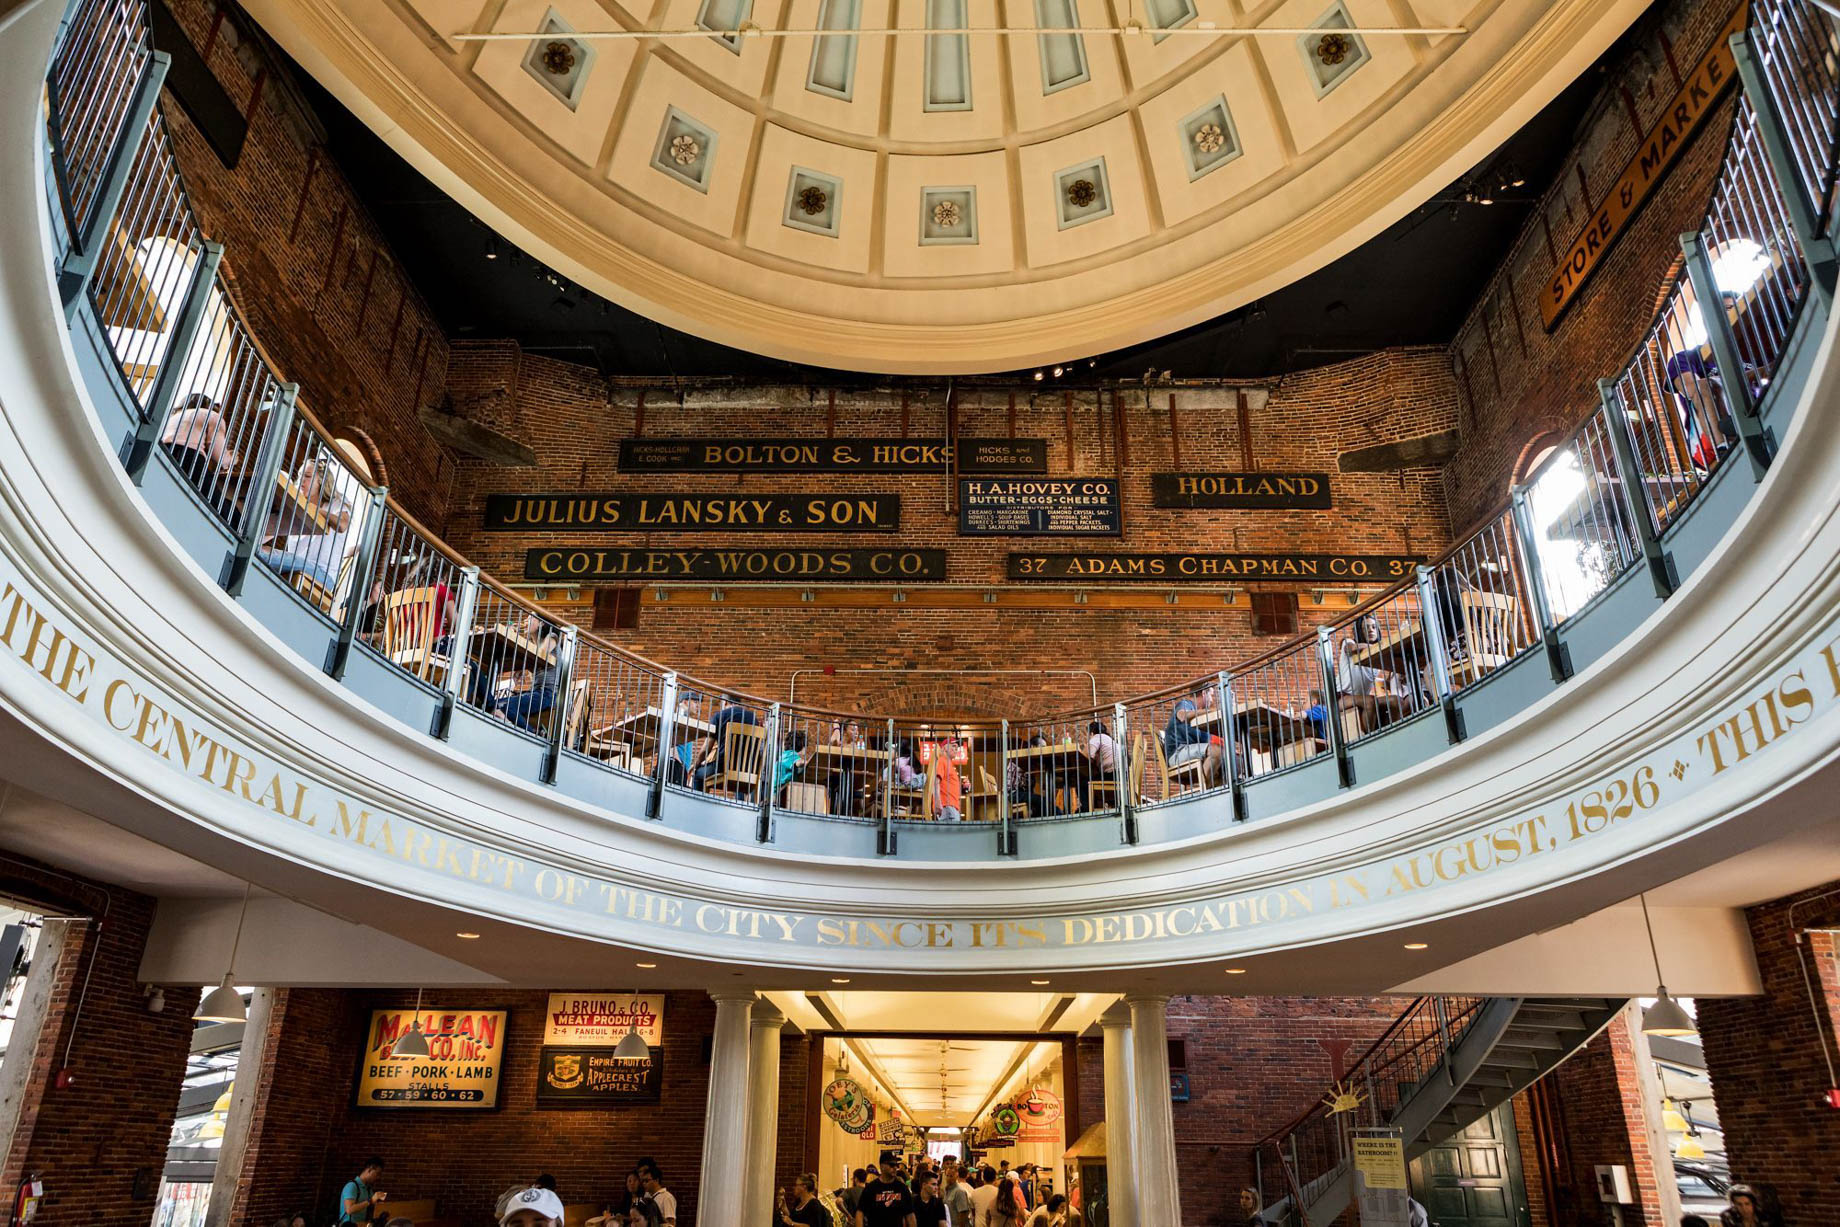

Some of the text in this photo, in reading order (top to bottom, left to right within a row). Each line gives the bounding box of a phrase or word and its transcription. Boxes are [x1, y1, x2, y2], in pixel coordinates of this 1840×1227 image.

[1551, 213, 1613, 304] STORE
[1619, 182, 1634, 209] &
[704, 446, 955, 464] BOLTON & HICKS
[976, 455, 1034, 464] HODGES CO.
[1082, 483, 1111, 495] CO.
[1177, 476, 1319, 496] HOLLAND
[503, 500, 878, 524] JULIUS LANSKY & SON
[870, 552, 930, 575] CO.
[1019, 558, 1048, 573] 37
[1066, 557, 1166, 574] ADAMS
[1179, 556, 1318, 576] CHAPMAN
[1389, 560, 1416, 575] 37
[0, 582, 1815, 949] THE CENTRAL MARKET OF THE CITY SINCE ITS DEDICATION IN AUGUST, 1826 THIS
[572, 1000, 617, 1015] BRUNO
[618, 1006, 626, 1015] &
[558, 1015, 651, 1026] MEAT PRODUCTS
[553, 1027, 568, 1035] 2-4
[575, 1027, 608, 1035] FANEUIL
[612, 1028, 635, 1036] HAL
[430, 1036, 457, 1060] CO.
[589, 1056, 615, 1067] EMPIRE
[619, 1058, 640, 1067] FRUIT
[369, 1065, 493, 1079] BEEF PORK LAMB
[586, 1068, 650, 1087] APPLECREST
[409, 1082, 450, 1090] STALLS
[826, 1082, 857, 1098] JOEY'S
[380, 1090, 475, 1100] 57 59 60 62
[828, 1104, 861, 1120] Gelateria
[841, 1119, 872, 1133] ESTROOMS
